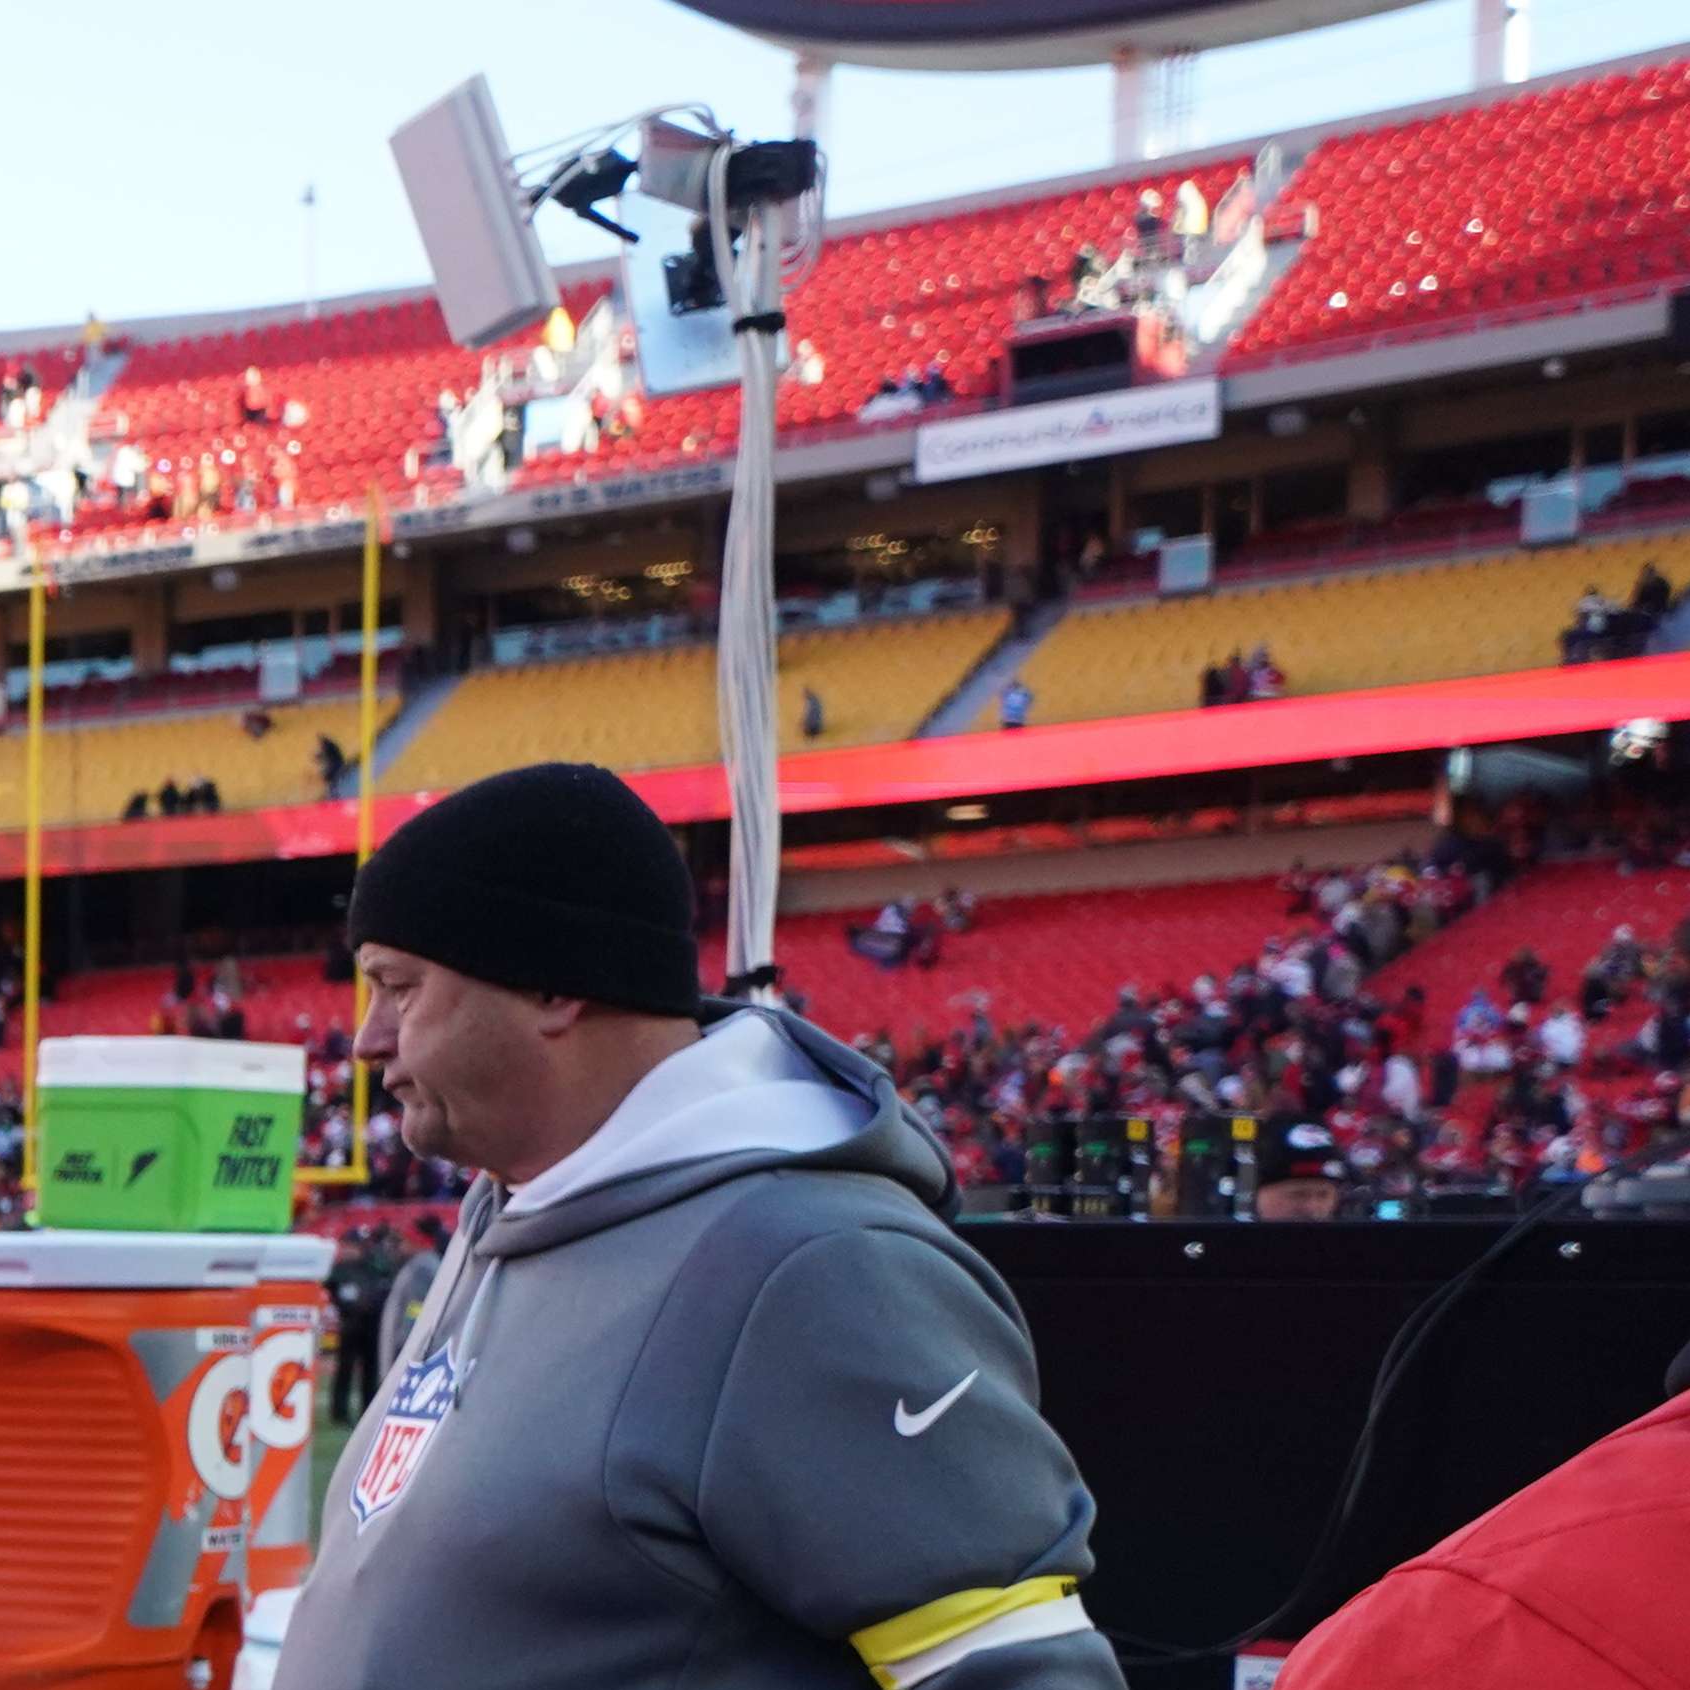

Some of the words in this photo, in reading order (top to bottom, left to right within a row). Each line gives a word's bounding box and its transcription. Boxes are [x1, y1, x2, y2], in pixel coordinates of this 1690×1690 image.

[213, 1152, 282, 1188] TWITCH
[228, 1113, 275, 1148] FAST
[187, 1353, 254, 1500] G
[251, 1329, 313, 1449] G
[360, 1423, 427, 1505] NFL
